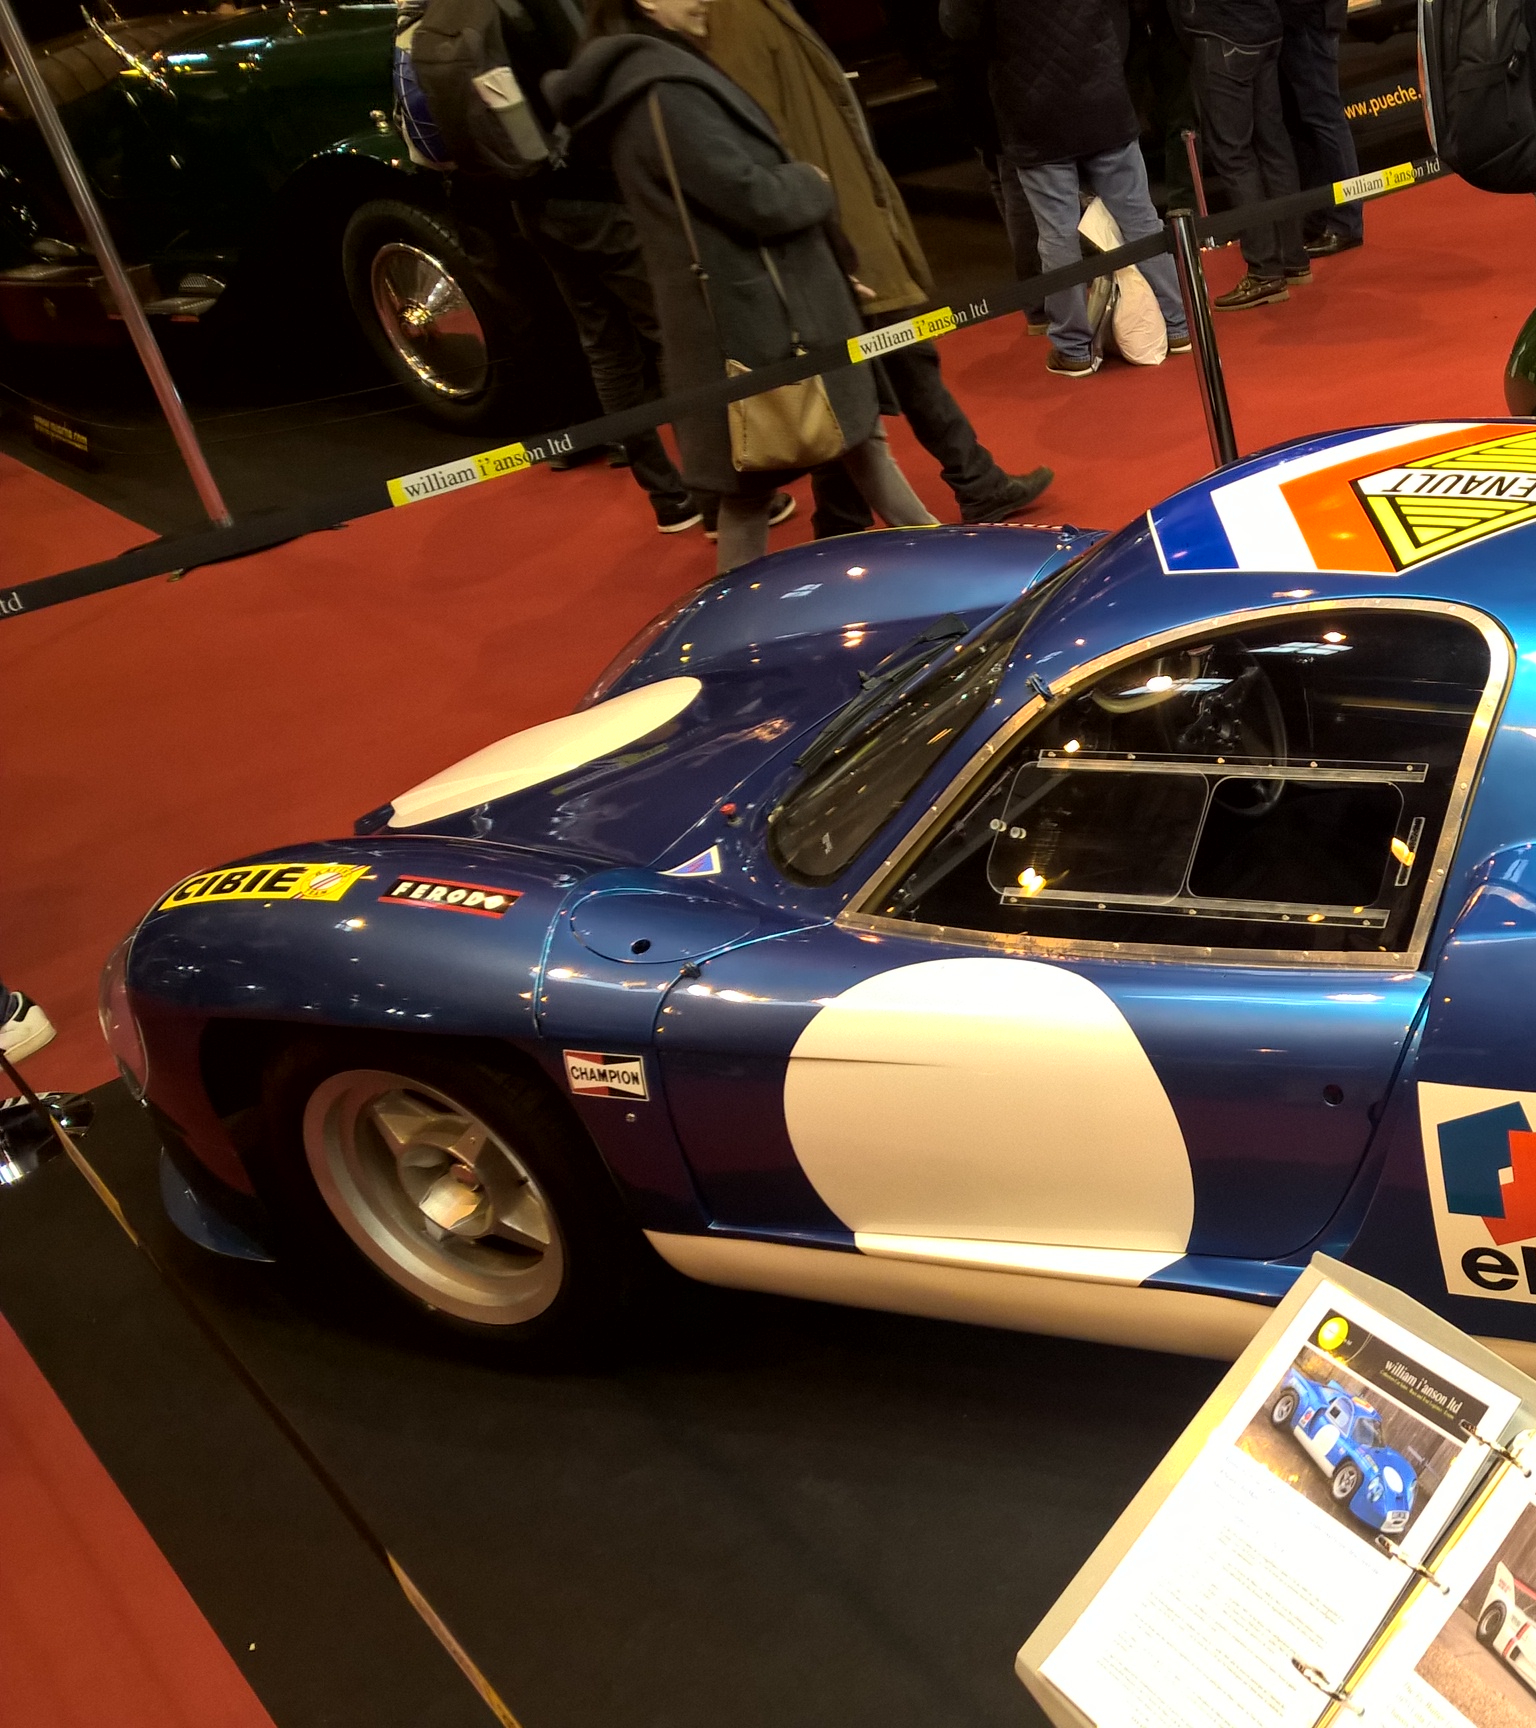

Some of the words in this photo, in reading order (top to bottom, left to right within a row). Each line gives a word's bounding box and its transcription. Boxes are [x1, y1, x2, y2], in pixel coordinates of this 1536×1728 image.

[1342, 176, 1384, 198] william
[1385, 165, 1424, 186] i'anson
[1425, 157, 1440, 175] ltd
[860, 327, 915, 355] william
[916, 310, 968, 337] i'anson
[969, 298, 989, 319] ltd
[405, 466, 476, 498] william
[477, 445, 547, 477] i'anson
[547, 433, 574, 456] ltd
[391, 881, 505, 910] FERODO
[570, 1065, 640, 1085] CHAMPION
[1384, 1360, 1418, 1388] william
[1416, 1377, 1449, 1406] i'anson
[1446, 1396, 1463, 1414] ltd
